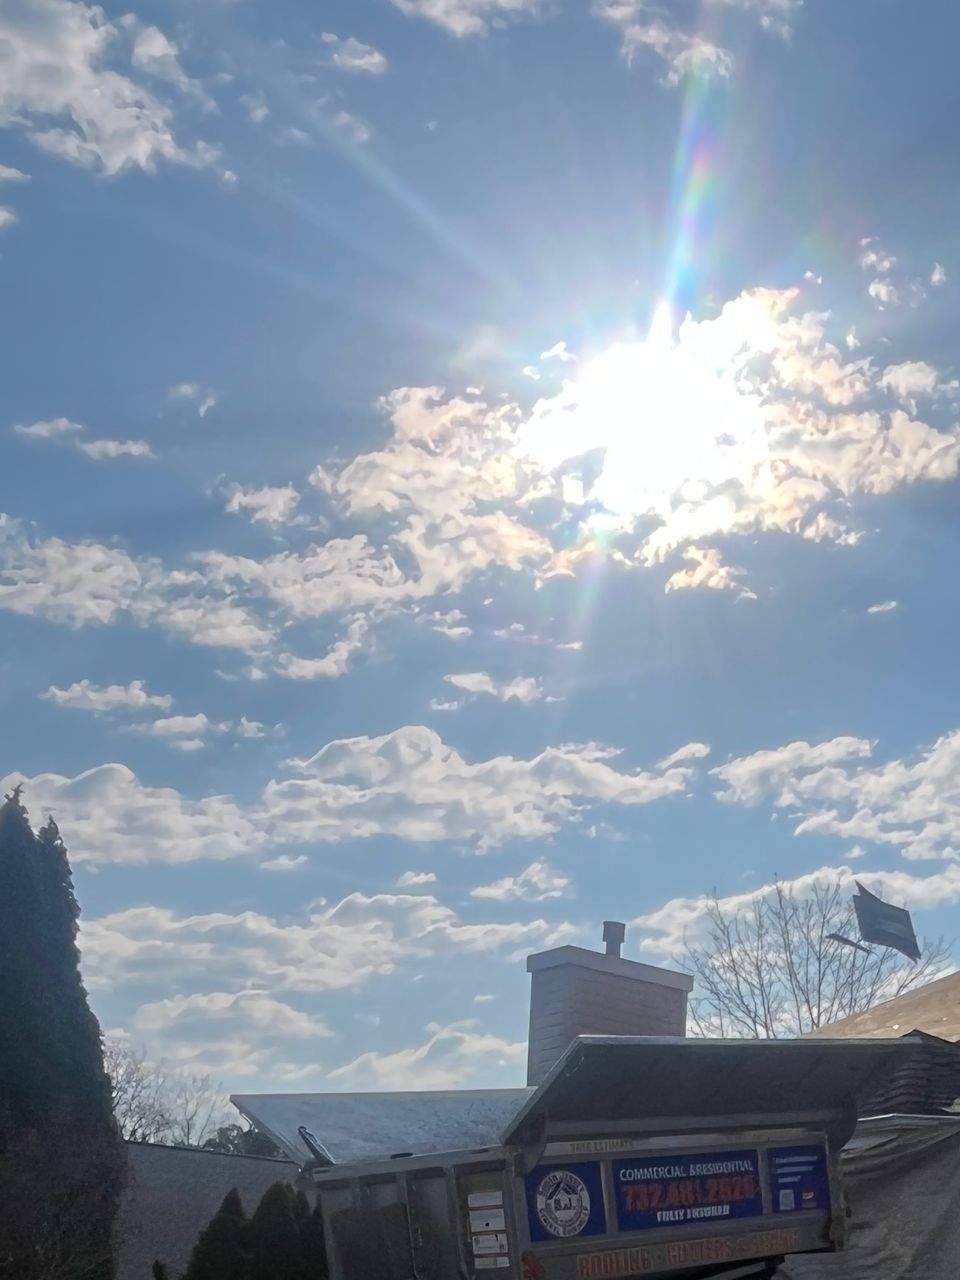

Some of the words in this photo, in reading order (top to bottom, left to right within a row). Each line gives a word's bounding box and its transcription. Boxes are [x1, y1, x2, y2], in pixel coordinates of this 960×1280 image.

[619, 1167, 687, 1181] COMMERCIAL
[656, 1208, 685, 1222] FULLY
[577, 1249, 650, 1280] ROOFING
[666, 1239, 732, 1265] GUTTERS
